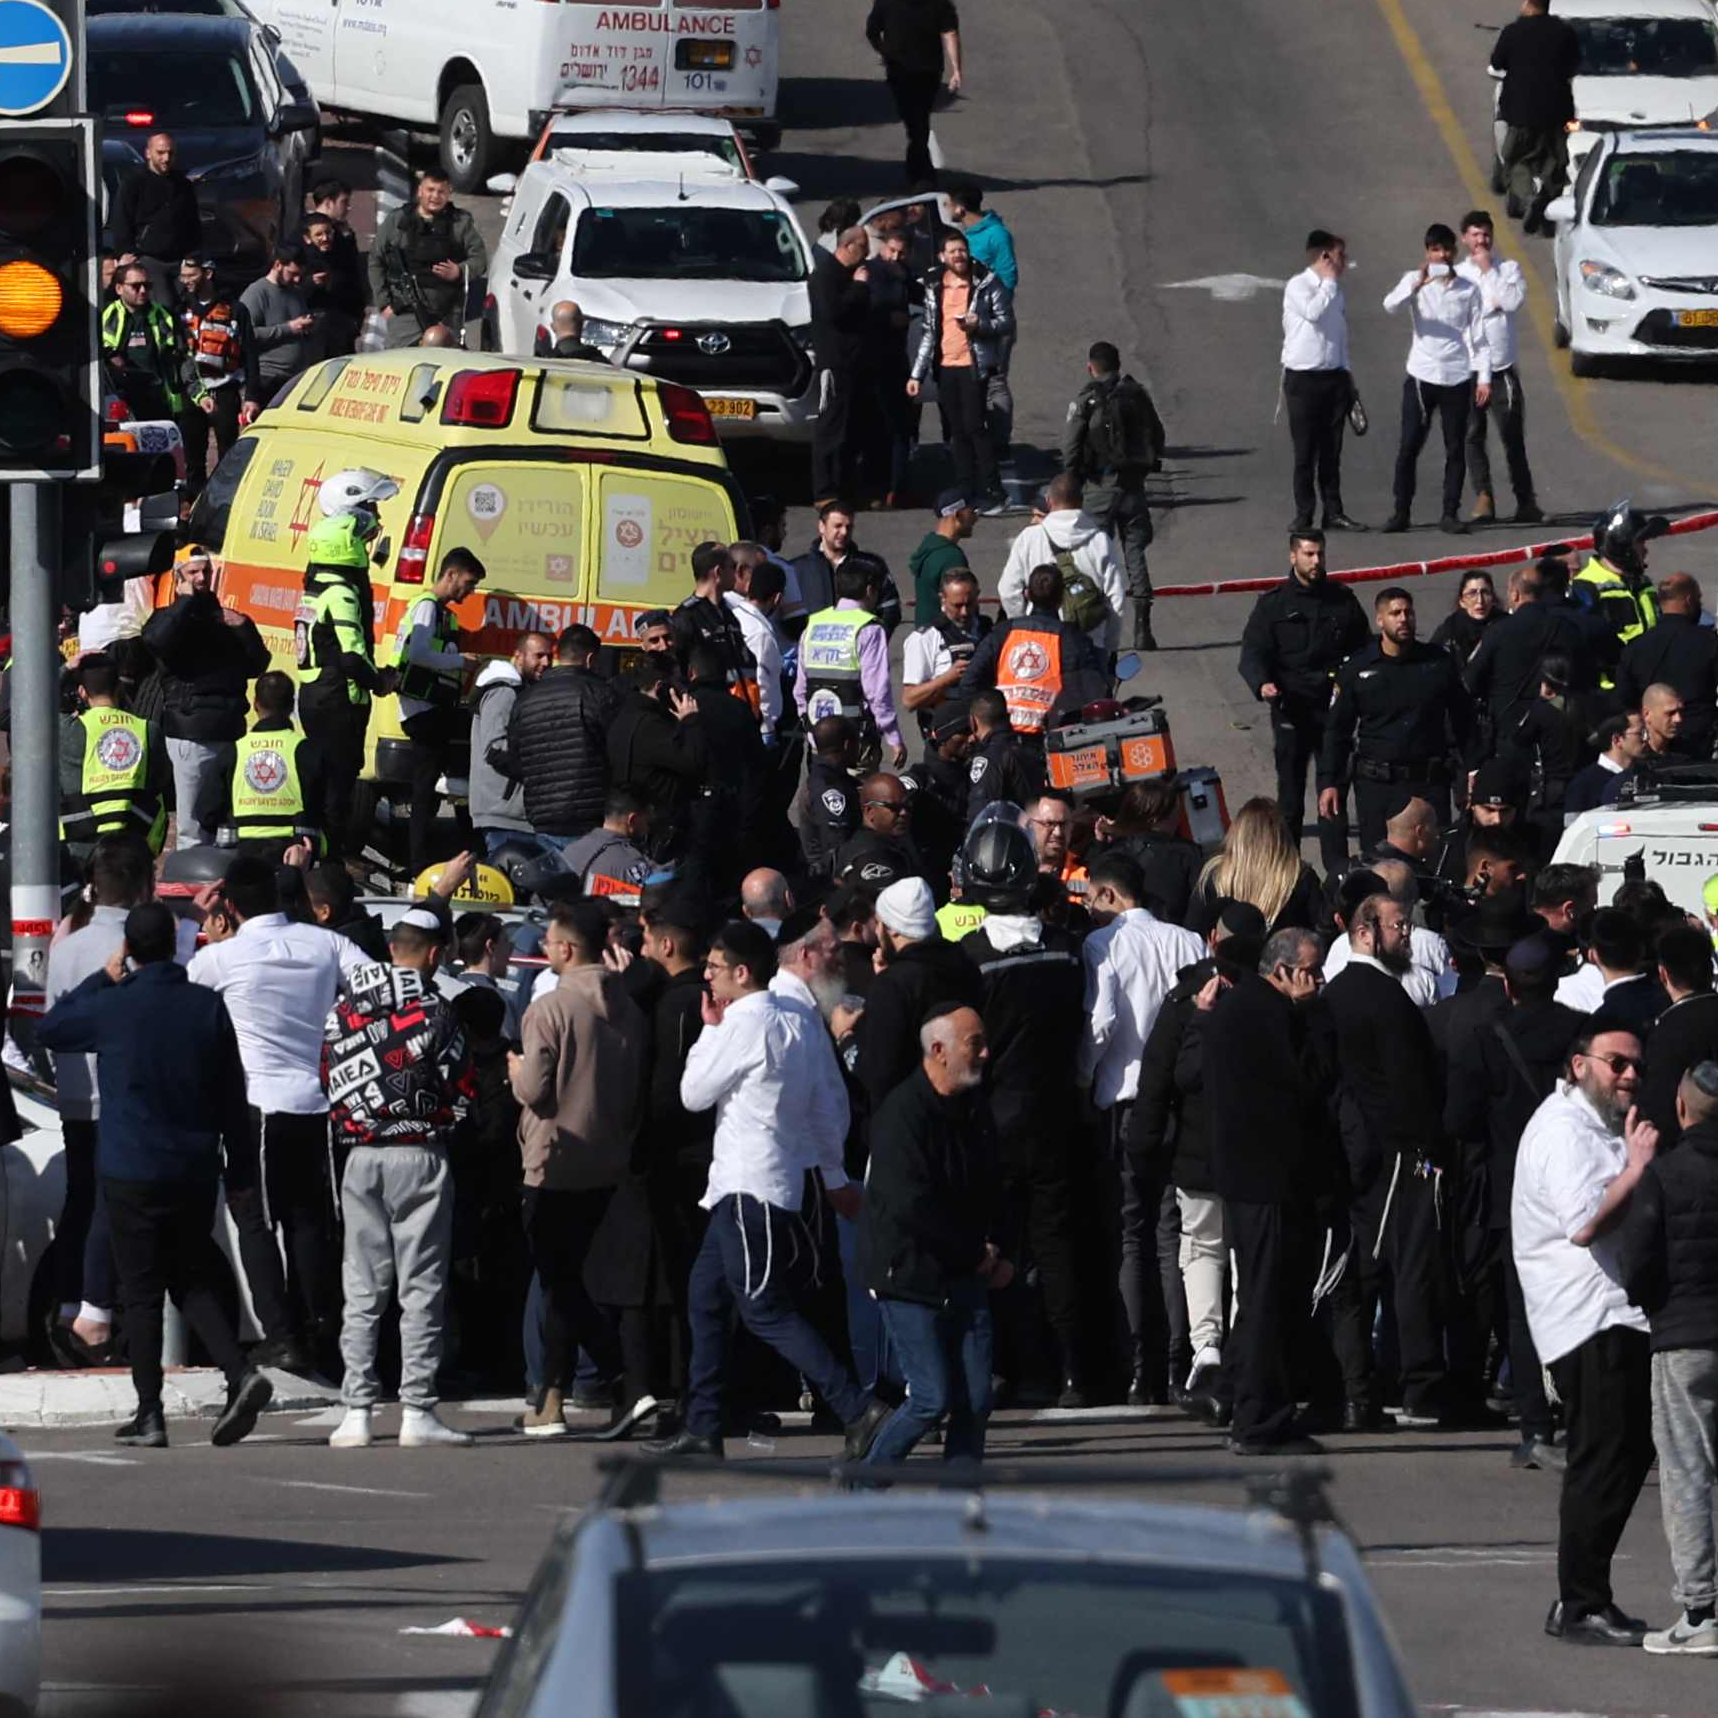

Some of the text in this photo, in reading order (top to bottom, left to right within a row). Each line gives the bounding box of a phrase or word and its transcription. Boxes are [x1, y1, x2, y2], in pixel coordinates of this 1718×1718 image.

[596, 10, 736, 34] AMBULANCE
[570, 43, 653, 62] מגן דוד אדום
[560, 63, 608, 80] ירושלים
[620, 65, 659, 91] 1344
[684, 72, 713, 91] 101
[483, 596, 644, 639] AMBULA
[99, 714, 134, 726] חובש
[250, 739, 284, 749] חובש
[955, 914, 982, 928] ובש
